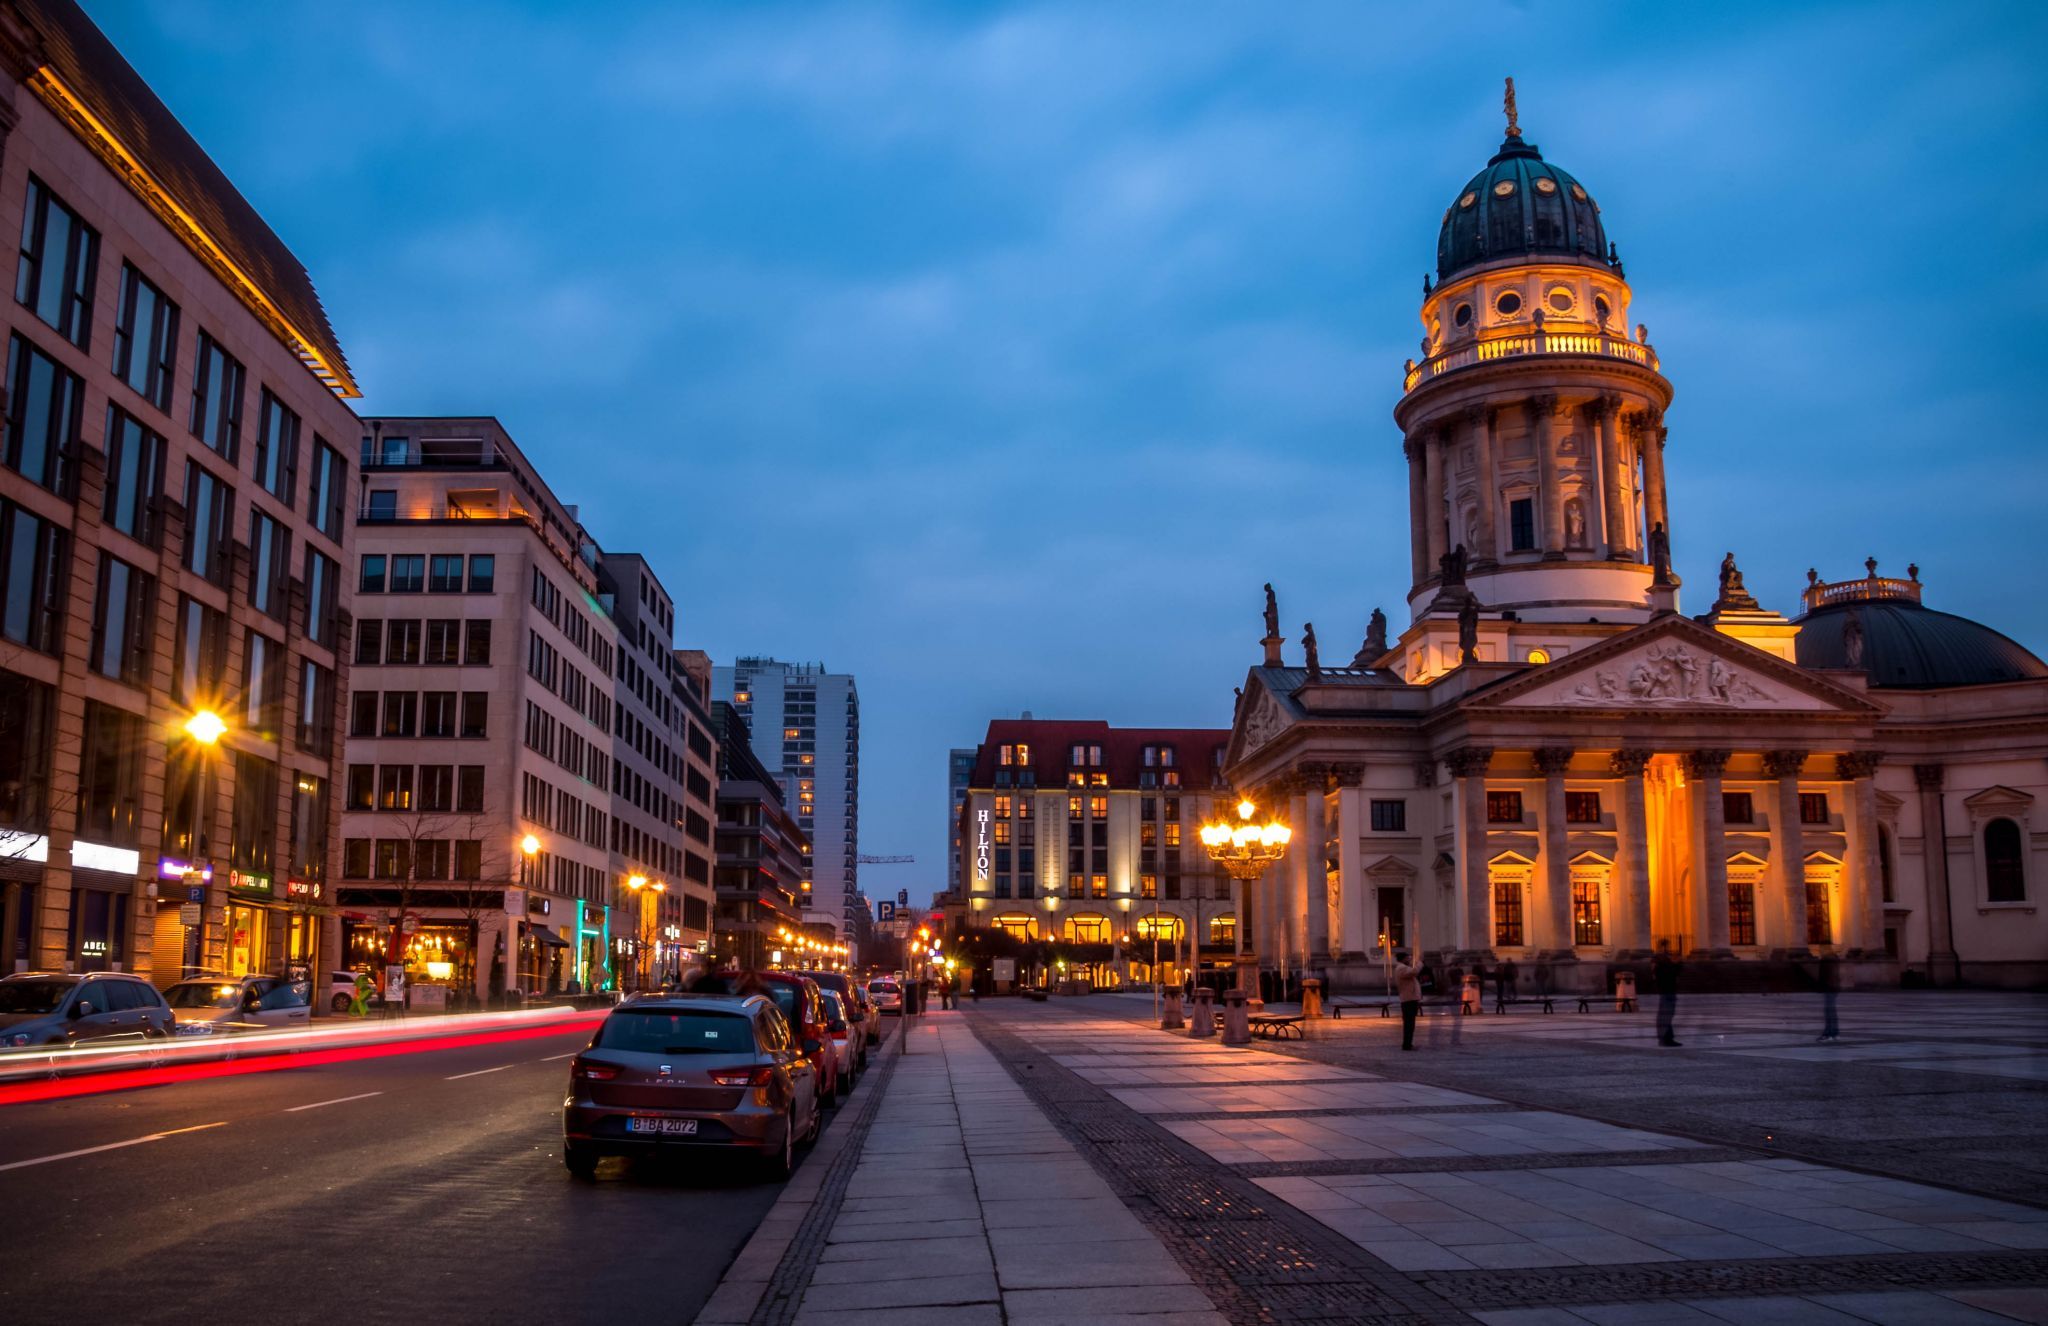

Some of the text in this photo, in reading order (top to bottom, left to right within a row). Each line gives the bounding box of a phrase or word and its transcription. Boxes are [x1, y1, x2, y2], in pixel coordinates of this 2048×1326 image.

[978, 810, 989, 880] HILTON
[192, 889, 199, 898] P
[881, 903, 892, 919] P
[83, 941, 107, 951] ABEL
[634, 1119, 641, 1129] B
[667, 1120, 696, 1132] 2072
